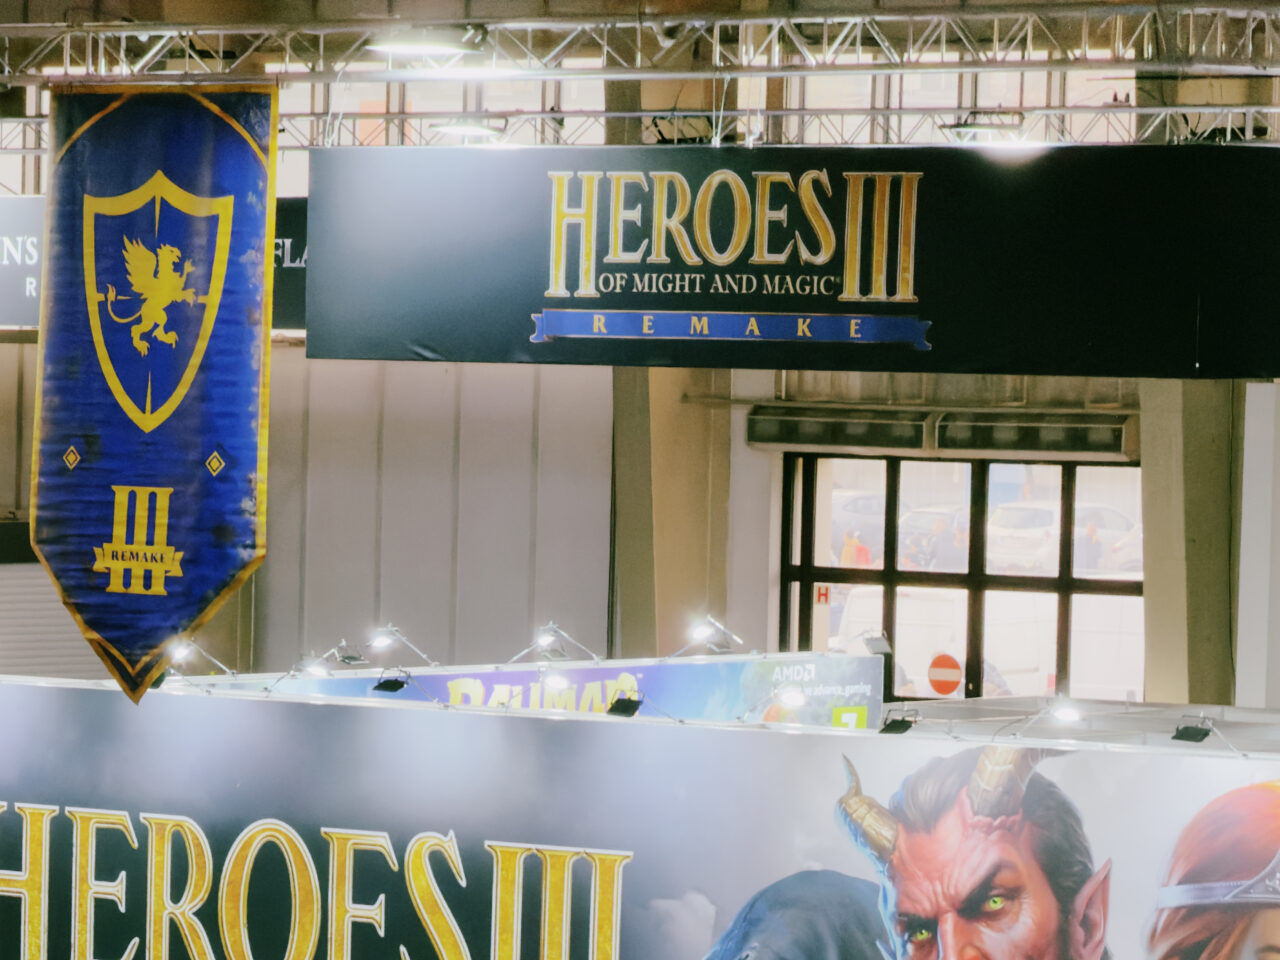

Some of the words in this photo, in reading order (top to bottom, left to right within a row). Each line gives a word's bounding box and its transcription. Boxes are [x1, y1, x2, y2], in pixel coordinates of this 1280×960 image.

[544, 168, 836, 298] HEROES
[837, 171, 923, 302] III
[598, 273, 626, 293] OF
[632, 273, 706, 295] MIGHT
[709, 274, 757, 295] AND
[593, 314, 863, 338] REMAKE
[105, 485, 174, 596] III
[110, 549, 166, 563] REMAKE
[817, 586, 829, 603] H
[772, 665, 803, 681] AMD
